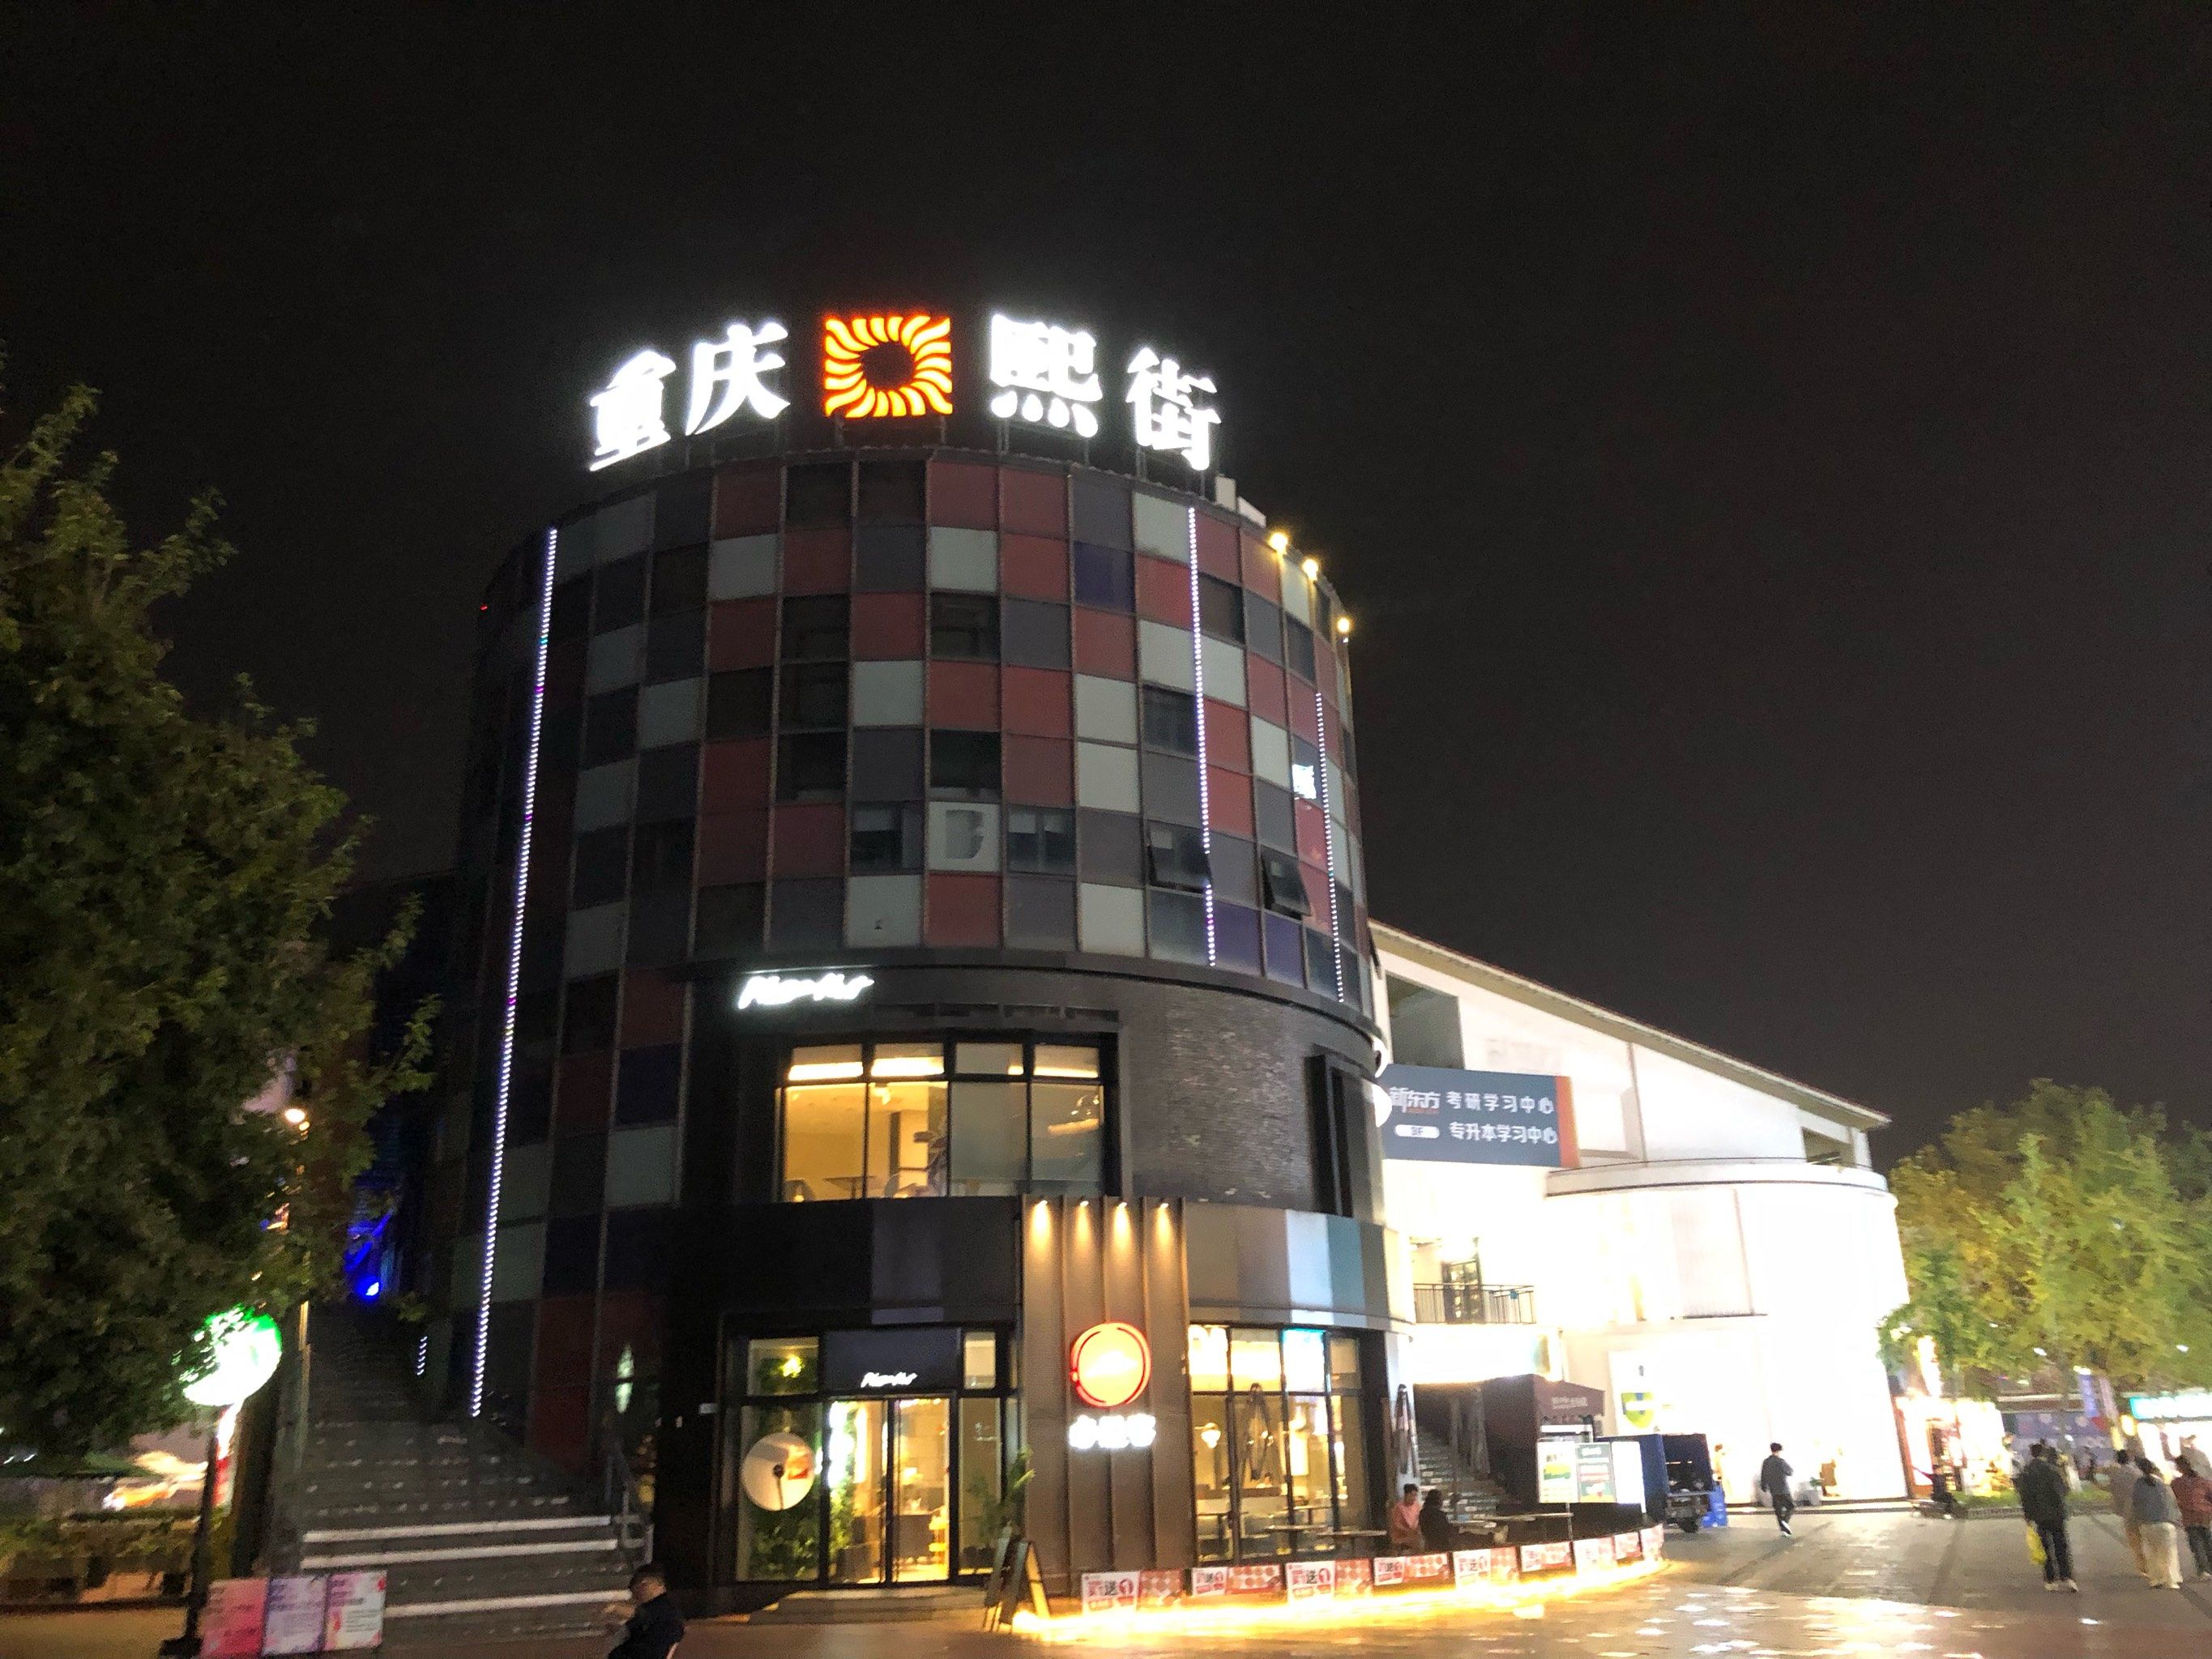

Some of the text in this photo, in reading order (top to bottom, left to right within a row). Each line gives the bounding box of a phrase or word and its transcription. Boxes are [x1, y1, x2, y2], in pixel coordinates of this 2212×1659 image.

[588, 312, 1222, 474] 重庆 熙街
[1389, 1086, 1556, 1115] 新东方 考研学习中心
[1449, 1121, 1558, 1145] 专升本学习中心
